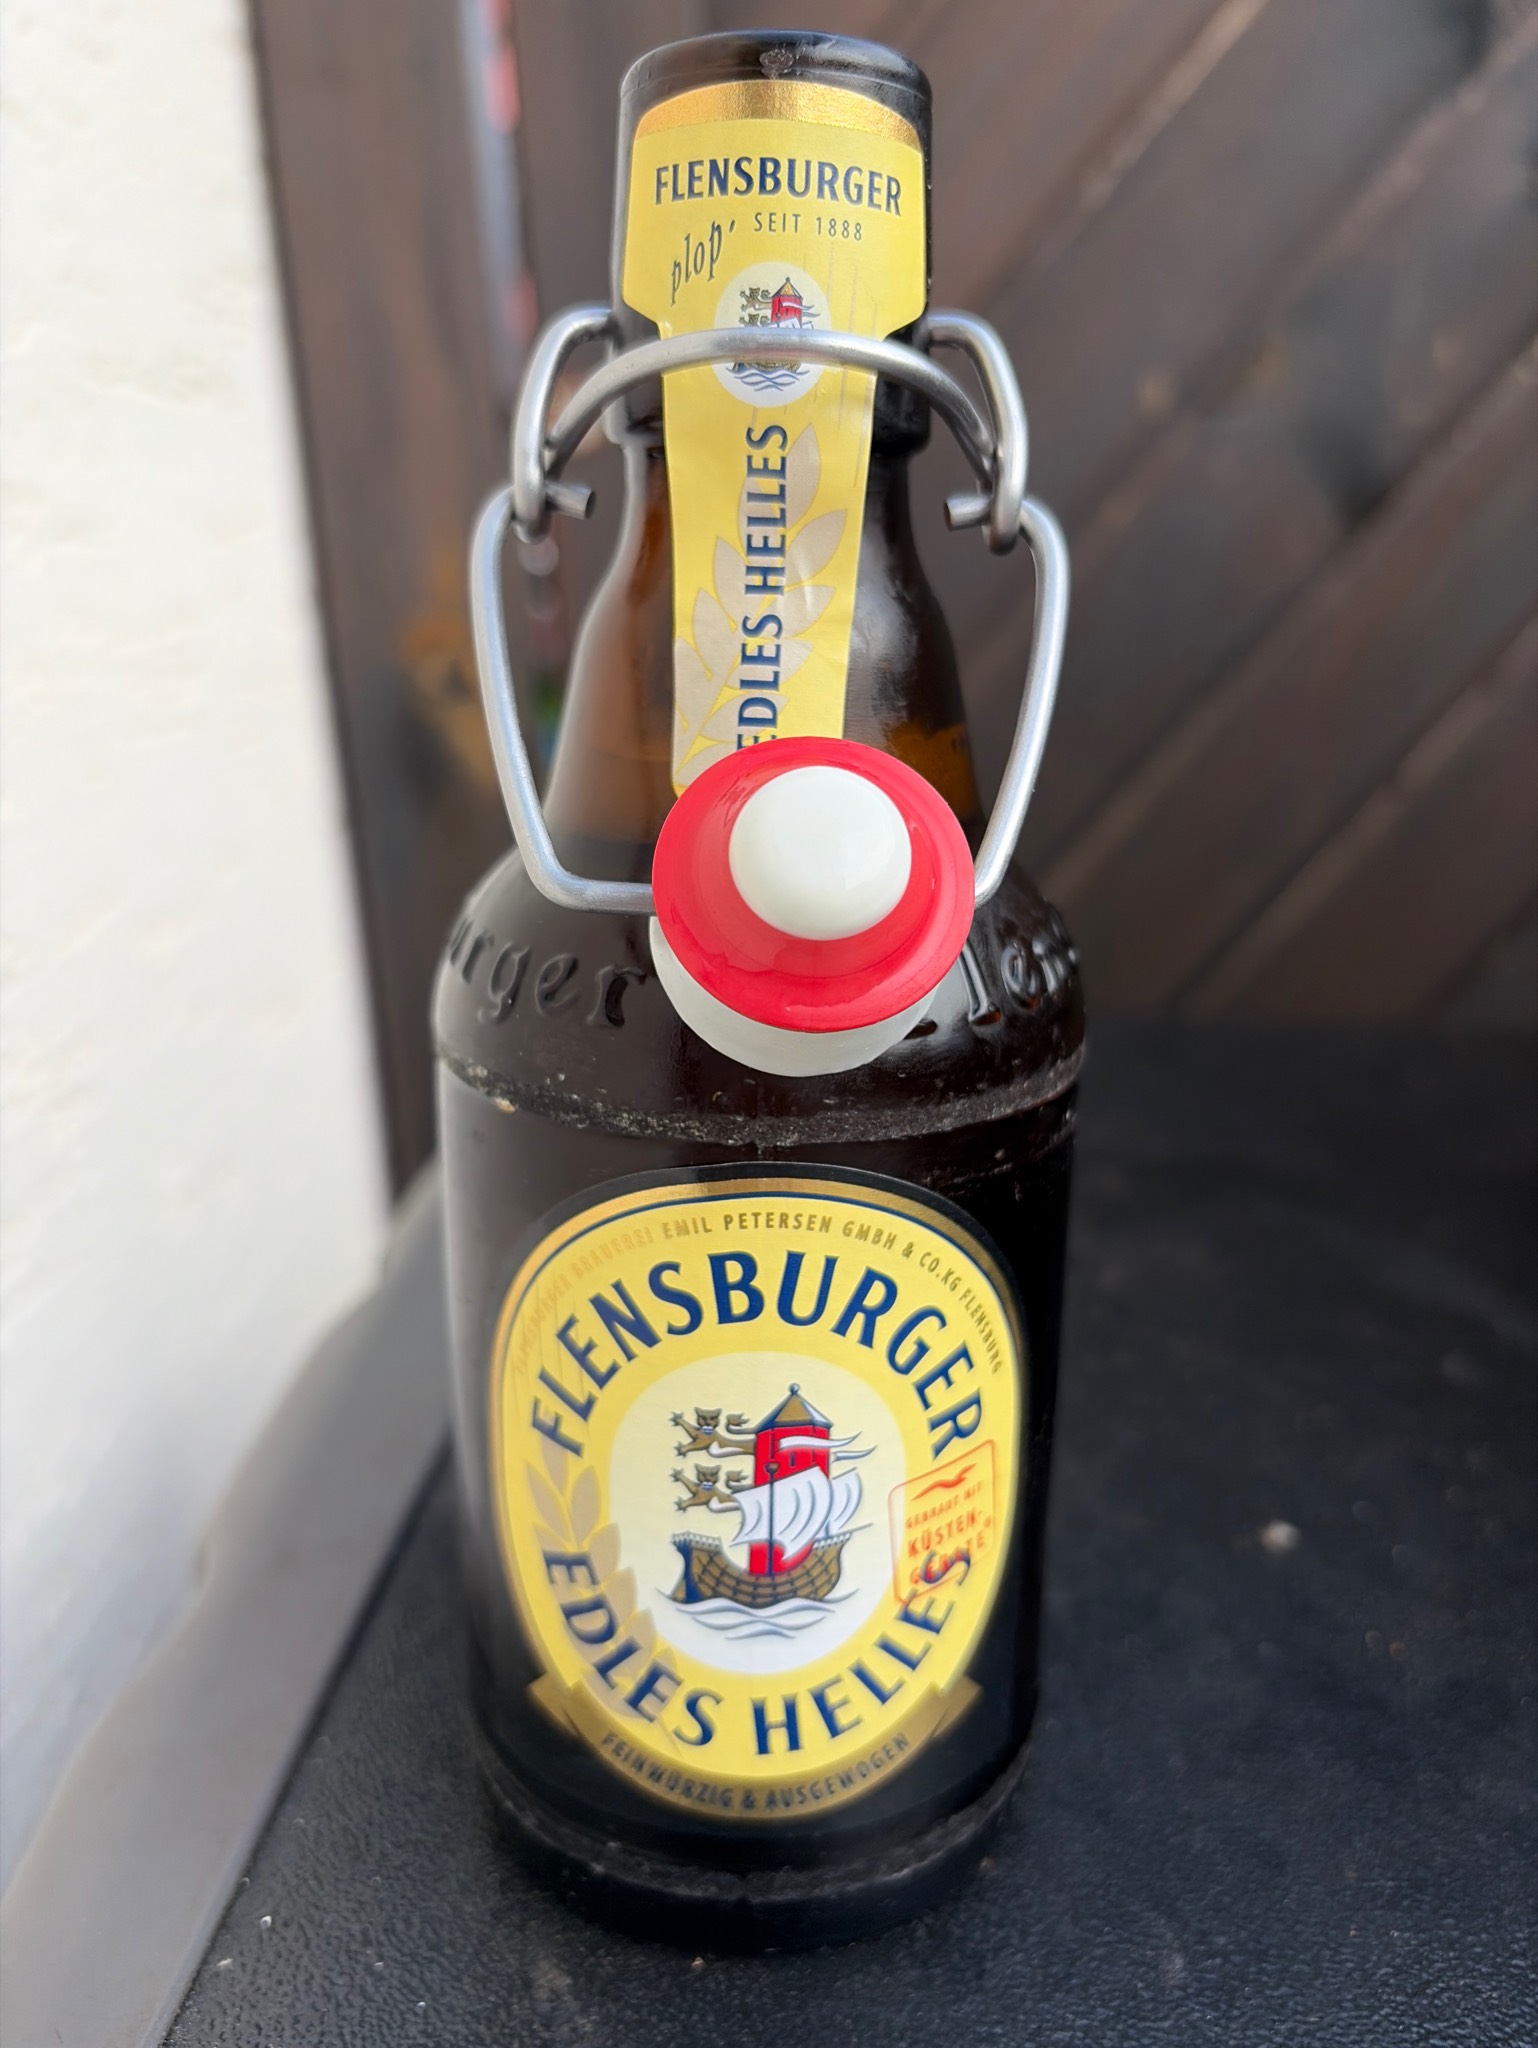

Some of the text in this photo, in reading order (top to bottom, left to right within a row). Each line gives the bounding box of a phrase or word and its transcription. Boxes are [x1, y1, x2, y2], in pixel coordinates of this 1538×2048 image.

[655, 156, 902, 217] FLENSBURGER
[753, 211, 863, 241] SEIT 1888
[745, 424, 788, 597] HELLES
[530, 1248, 984, 1460] FLENSBURGER
[661, 1216, 713, 1240] EMIL
[723, 1211, 833, 1233] PETERSEN
[842, 1220, 898, 1250] GMBH
[902, 1241, 914, 1260] &
[958, 1287, 1006, 1375] FLENSBURG
[541, 1548, 971, 1756] EDLES HELLES
[601, 1731, 911, 1812] FEINWÜRZIG & AUSGEWOGEN
